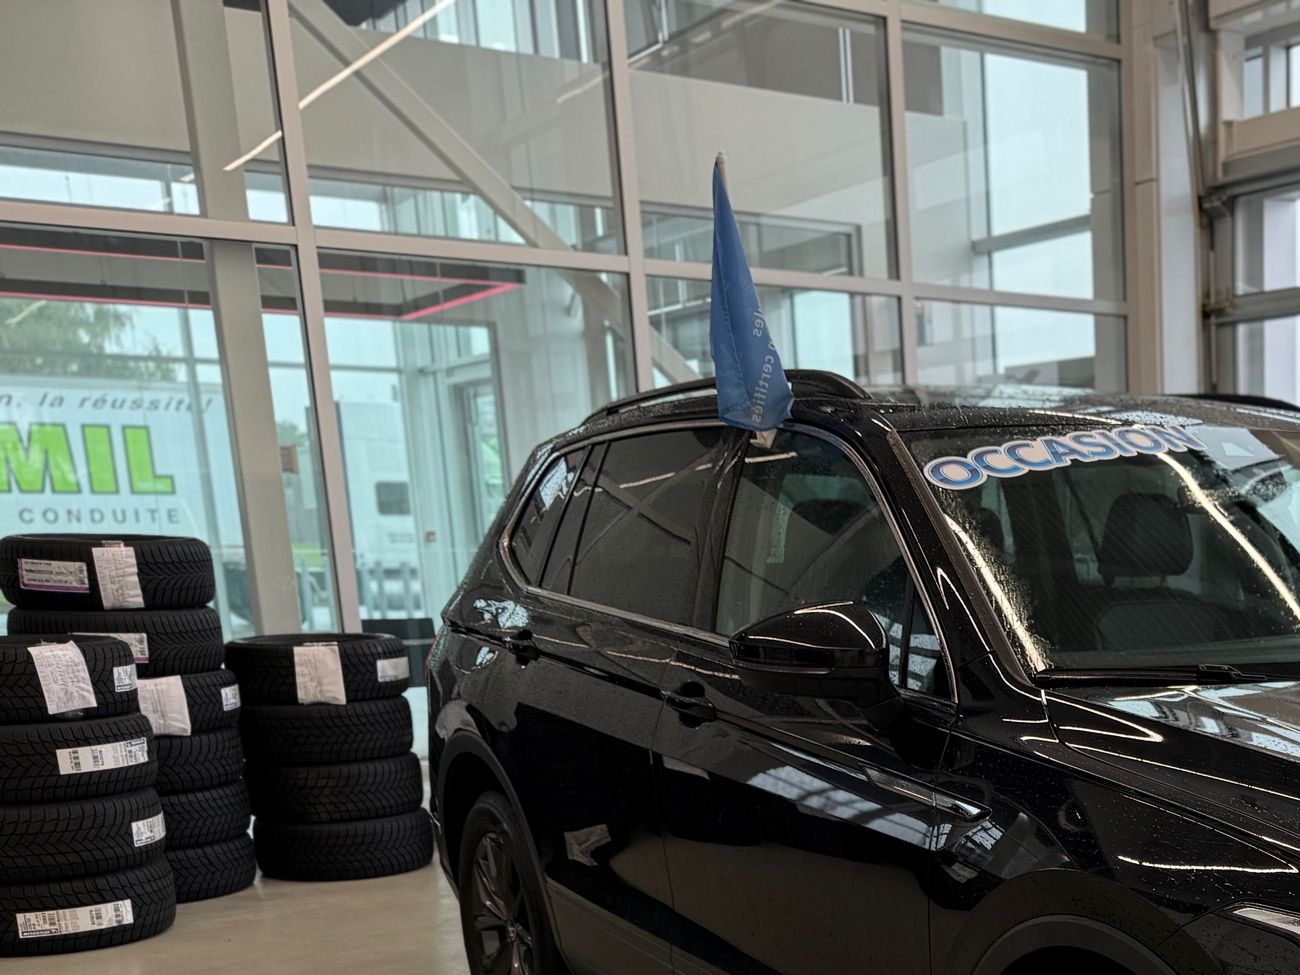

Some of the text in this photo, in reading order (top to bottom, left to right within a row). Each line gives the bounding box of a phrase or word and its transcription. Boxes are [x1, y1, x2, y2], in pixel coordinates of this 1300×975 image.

[38, 390, 65, 408] la
[925, 425, 1206, 489] OCCASION
[19, 507, 181, 525] CONDUITE
